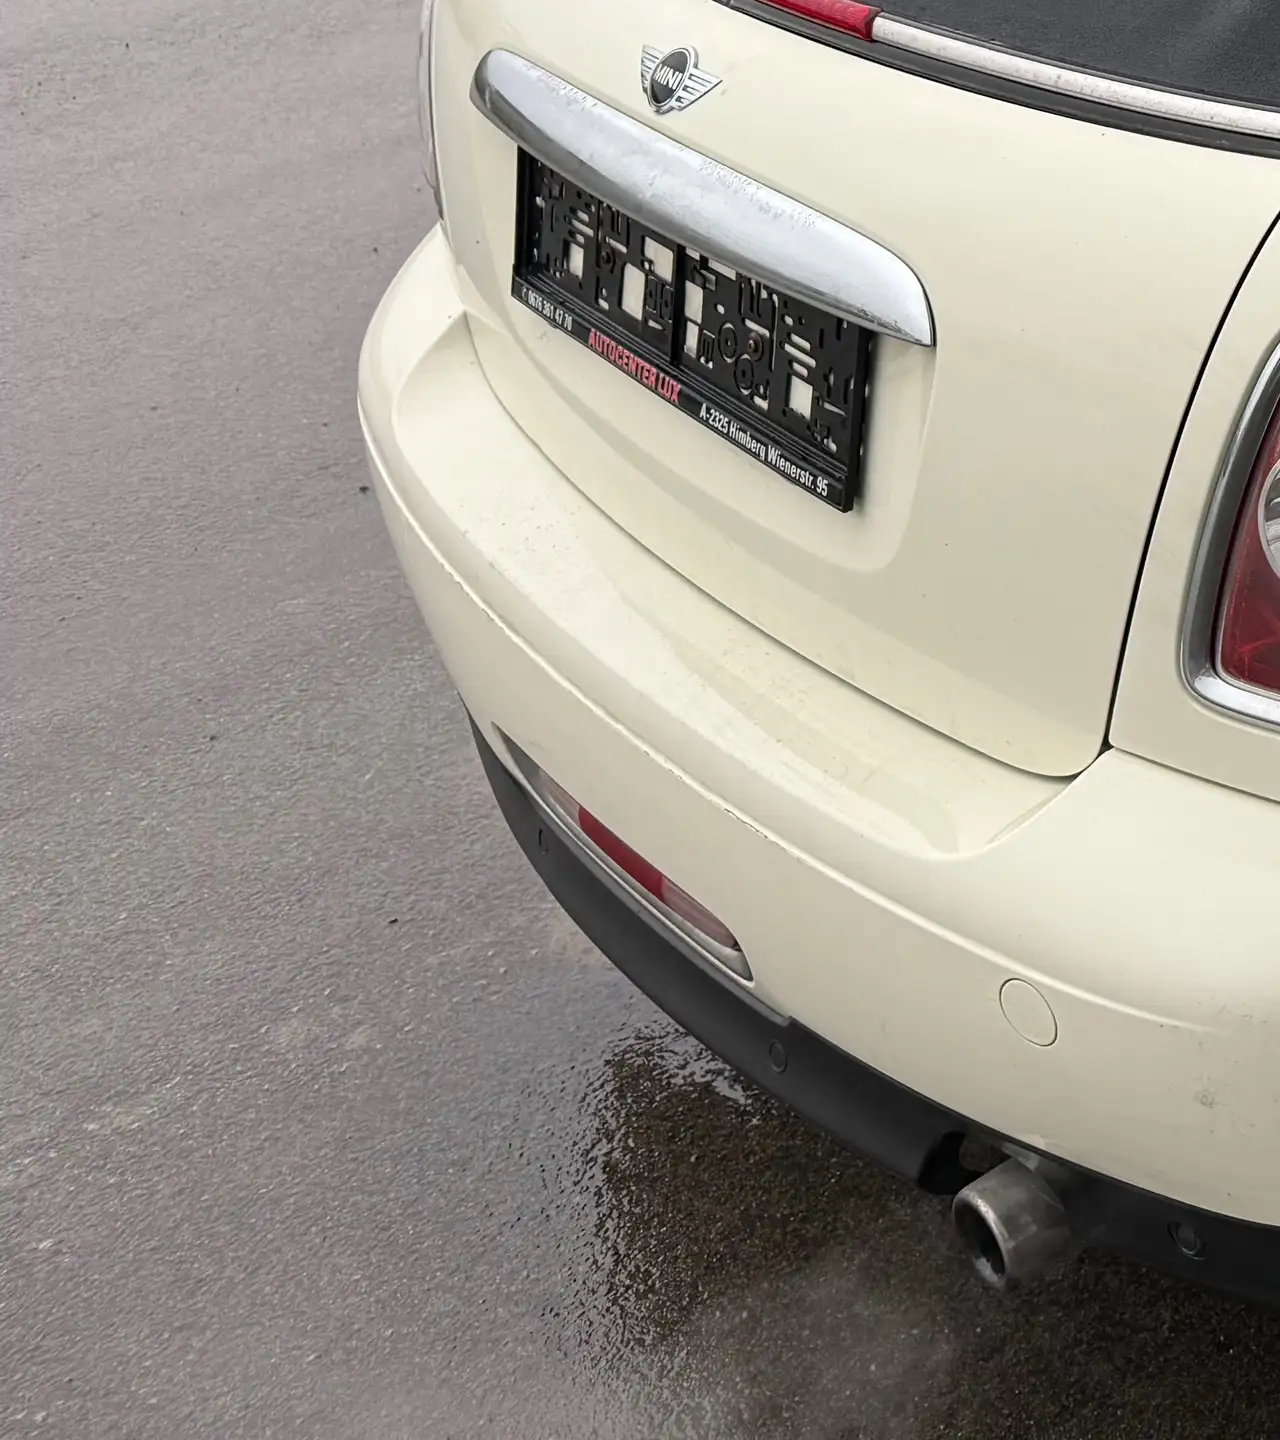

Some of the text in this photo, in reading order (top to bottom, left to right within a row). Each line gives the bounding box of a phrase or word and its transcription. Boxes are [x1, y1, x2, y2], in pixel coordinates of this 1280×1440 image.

[654, 63, 683, 90] MINI
[555, 308, 564, 325] 47
[564, 313, 573, 331] 70
[588, 327, 681, 404] AUTOCENTER LUX
[700, 402, 829, 497] A-2325 Himberg Wienerstr. 95
